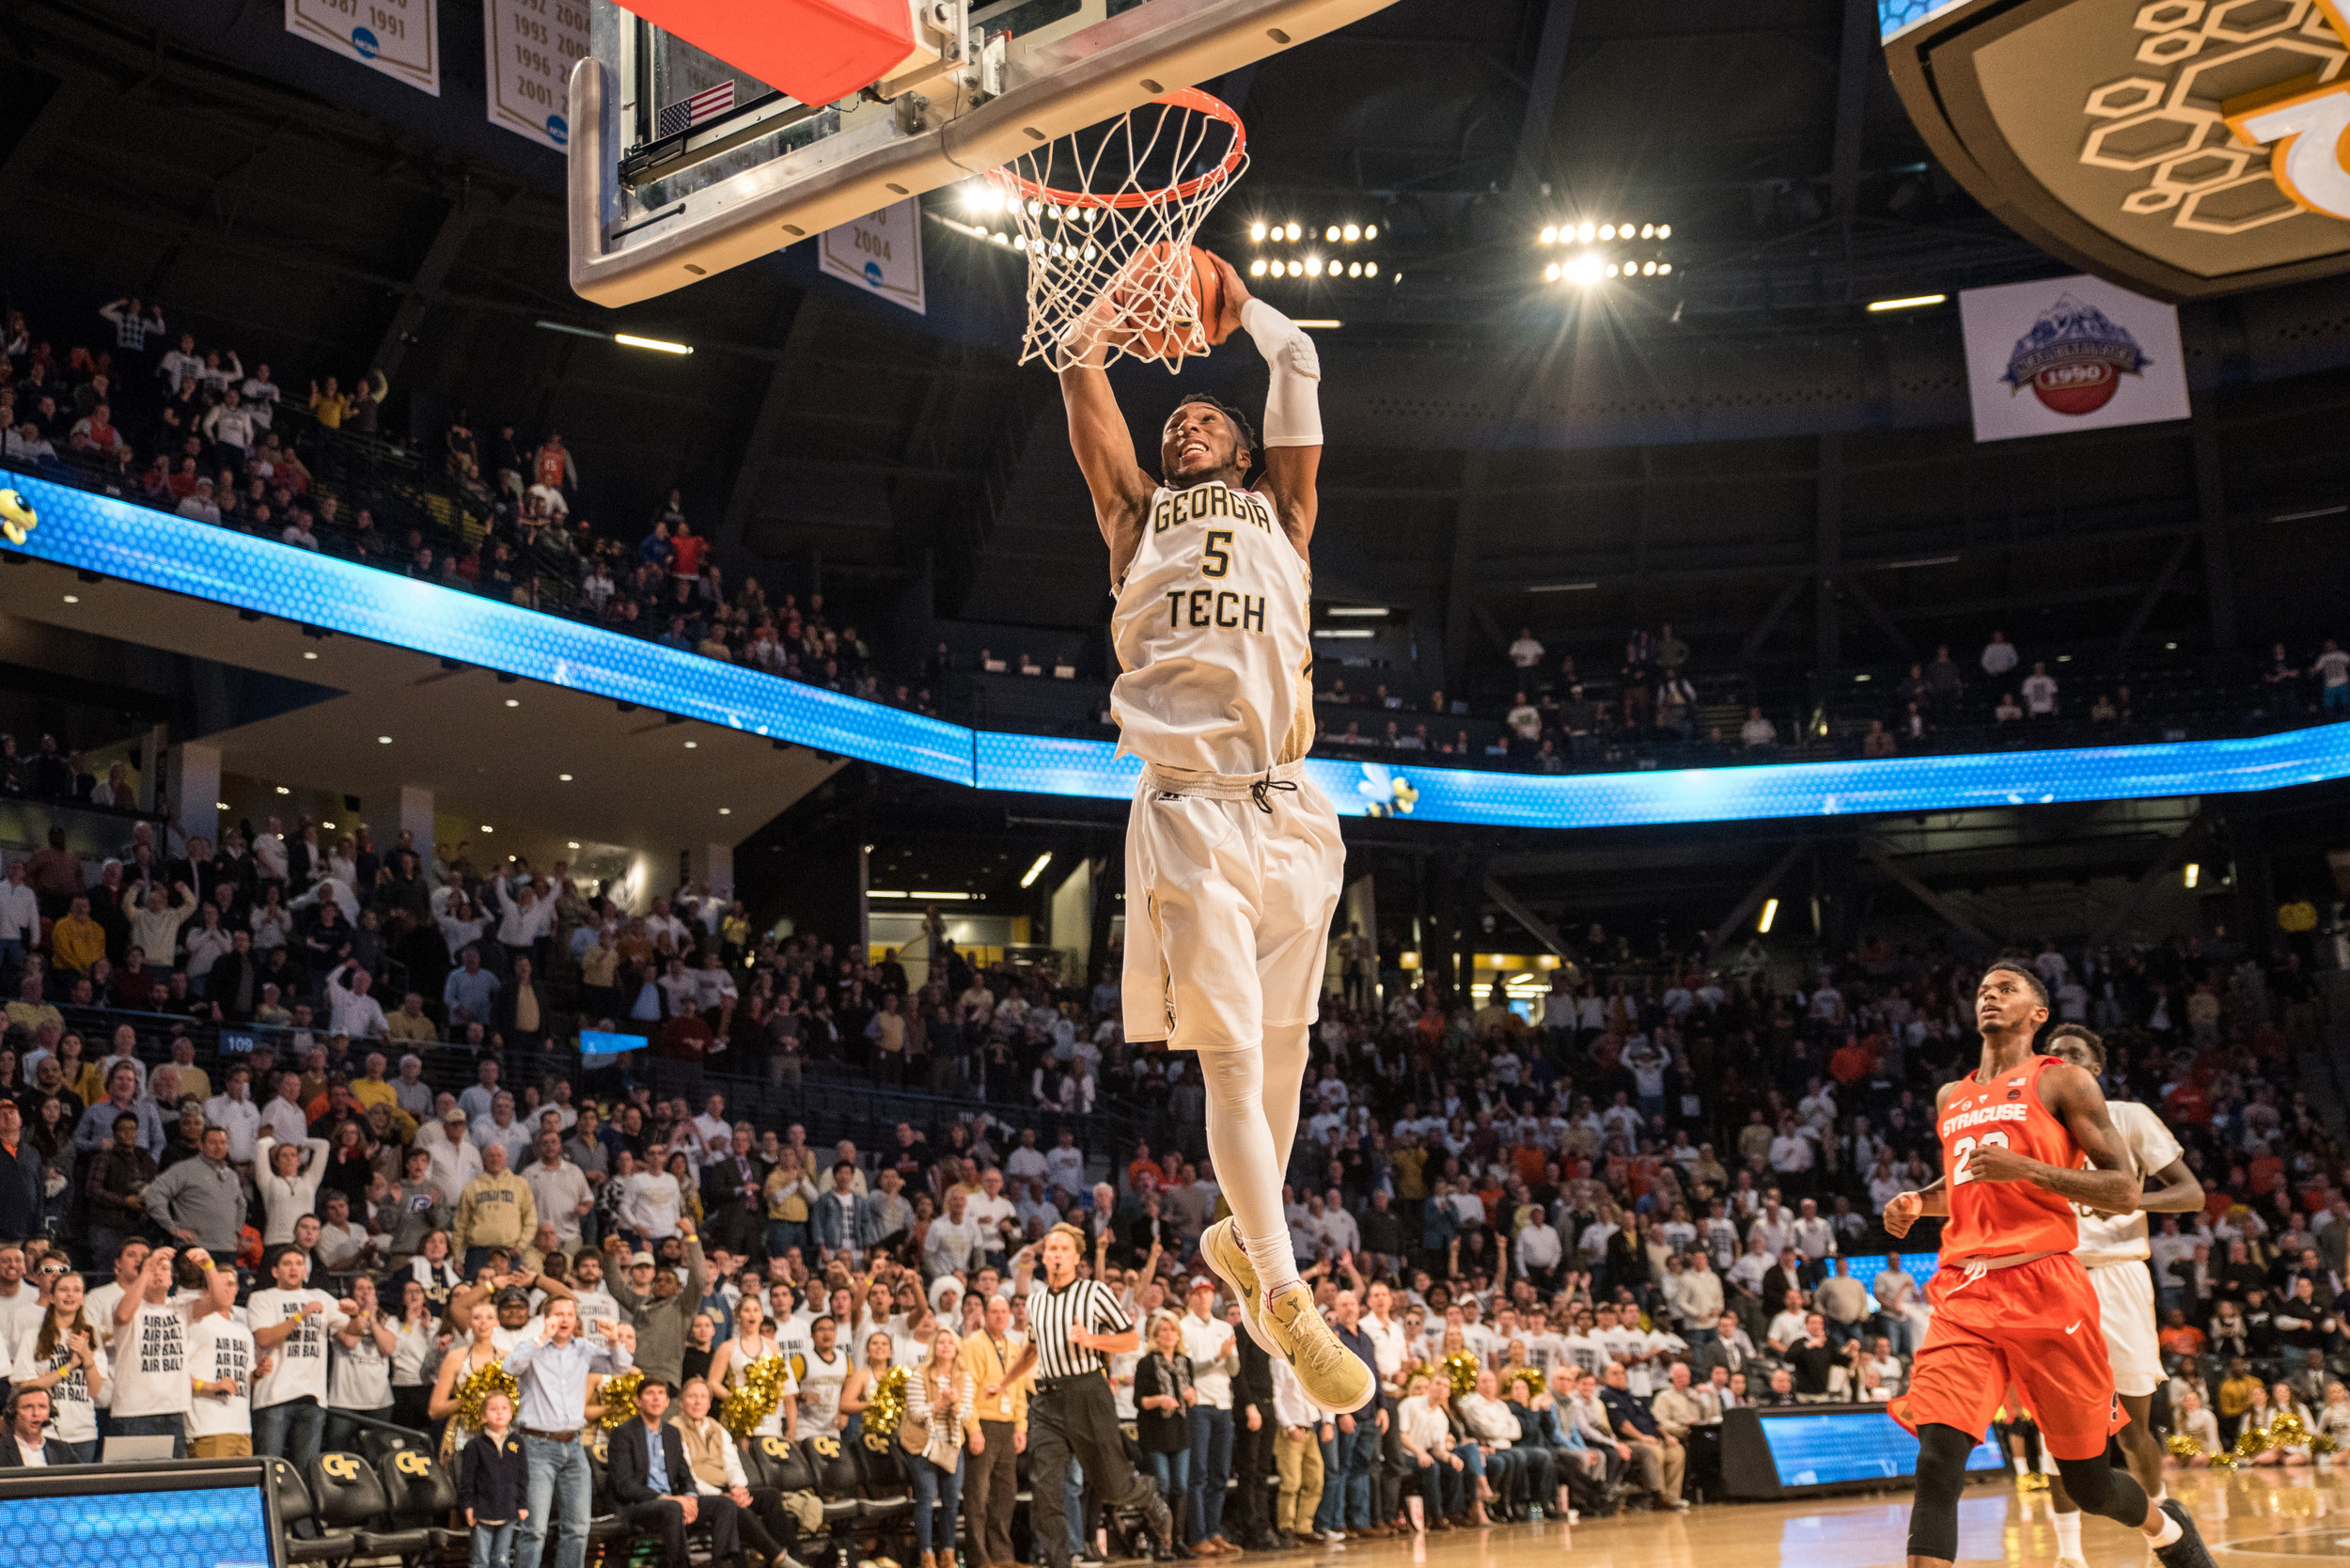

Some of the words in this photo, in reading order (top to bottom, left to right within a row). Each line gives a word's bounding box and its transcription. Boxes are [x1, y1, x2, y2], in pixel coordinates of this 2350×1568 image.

[322, 0, 356, 17] 87
[369, 5, 404, 39] 1991
[514, 12, 548, 45] 1993
[516, 44, 552, 76] 1996
[518, 75, 553, 108] 2001
[854, 226, 892, 262] 2004
[2046, 364, 2104, 385] 1990
[1154, 485, 1273, 535] GEORGIA
[1200, 528, 1235, 580] 5
[1165, 588, 1266, 635] TECH
[227, 1035, 254, 1053] 109
[1942, 1103, 2029, 1138] SYRACUSE
[144, 1315, 161, 1327] AIR
[143, 1328, 161, 1342] AIR
[215, 1338, 231, 1350] AIR
[141, 1343, 161, 1356] AIR
[215, 1353, 231, 1366] AIR
[141, 1358, 160, 1372] AIR
[592, 1444, 609, 1464] G
[761, 1436, 791, 1459] GT
[813, 1436, 841, 1458] GT
[863, 1433, 890, 1455] GT
[321, 1453, 361, 1481] GT
[394, 1450, 432, 1477] GT
